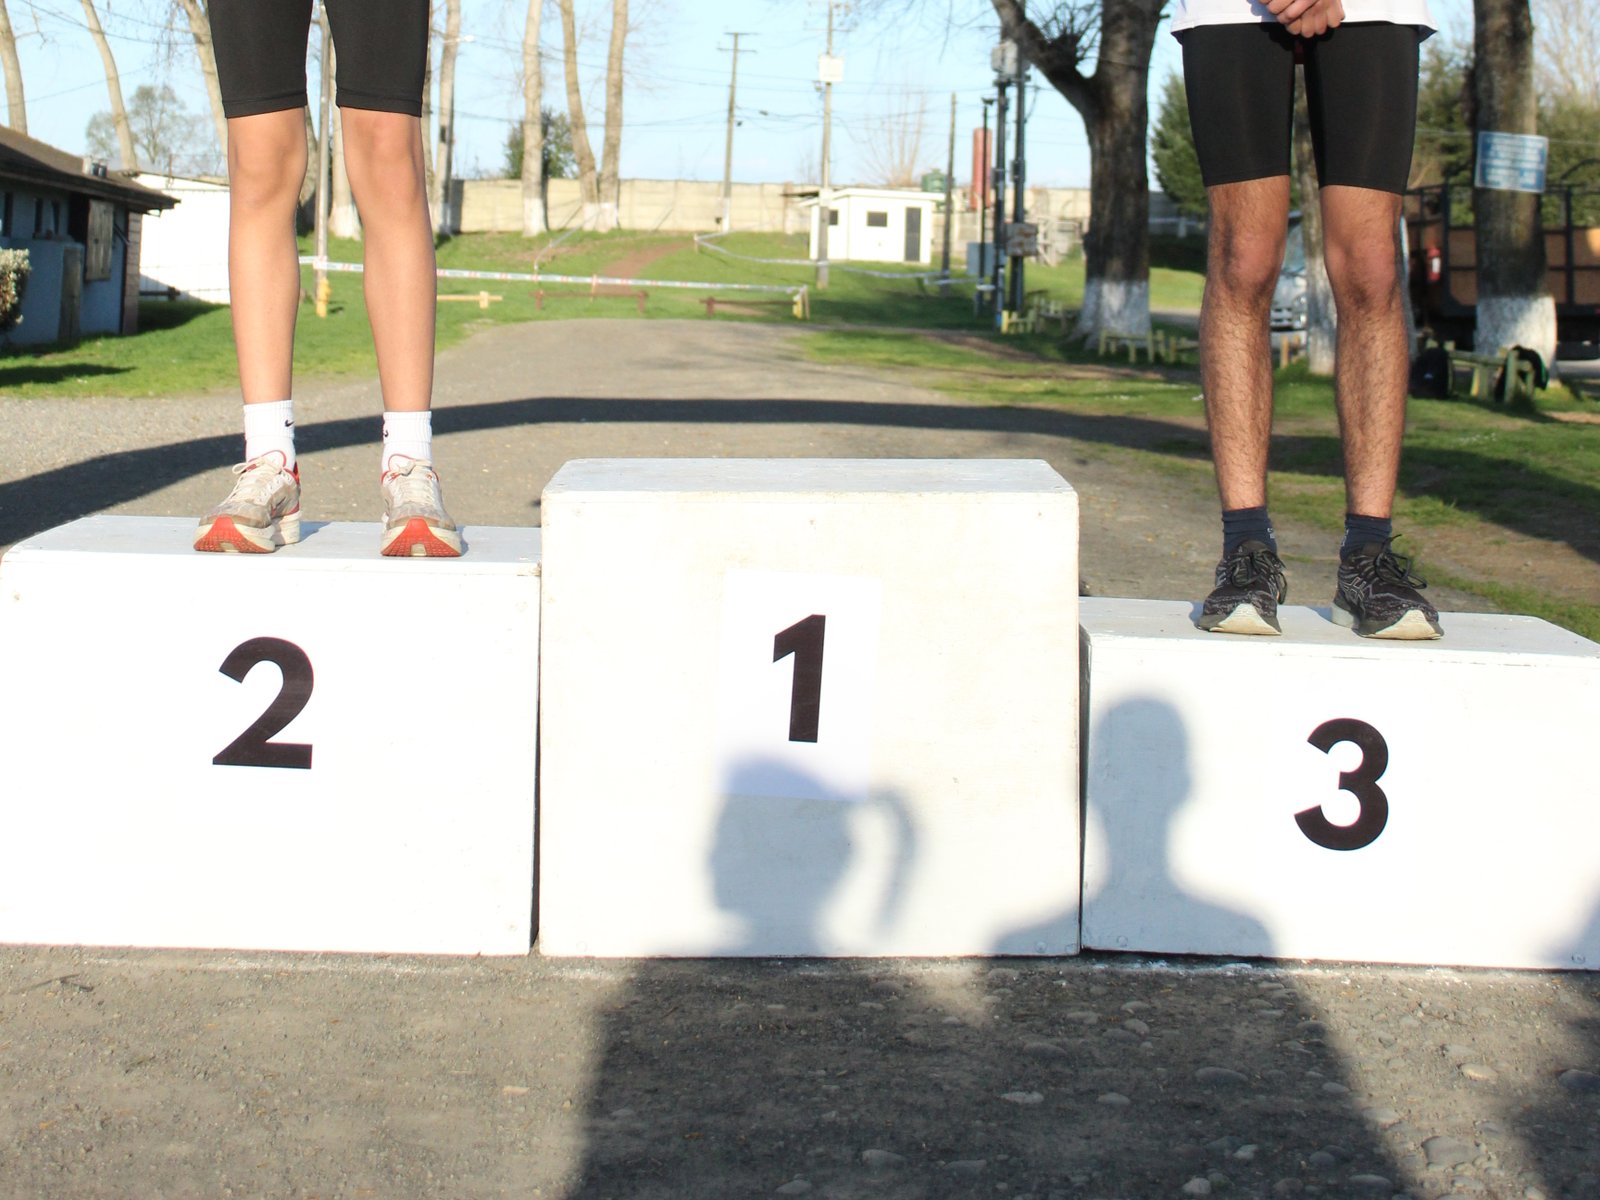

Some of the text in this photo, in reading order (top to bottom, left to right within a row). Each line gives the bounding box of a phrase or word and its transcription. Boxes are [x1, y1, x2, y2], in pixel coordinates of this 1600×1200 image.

[212, 638, 314, 769] 2
[773, 615, 826, 742] 1
[1294, 718, 1389, 851] 3
